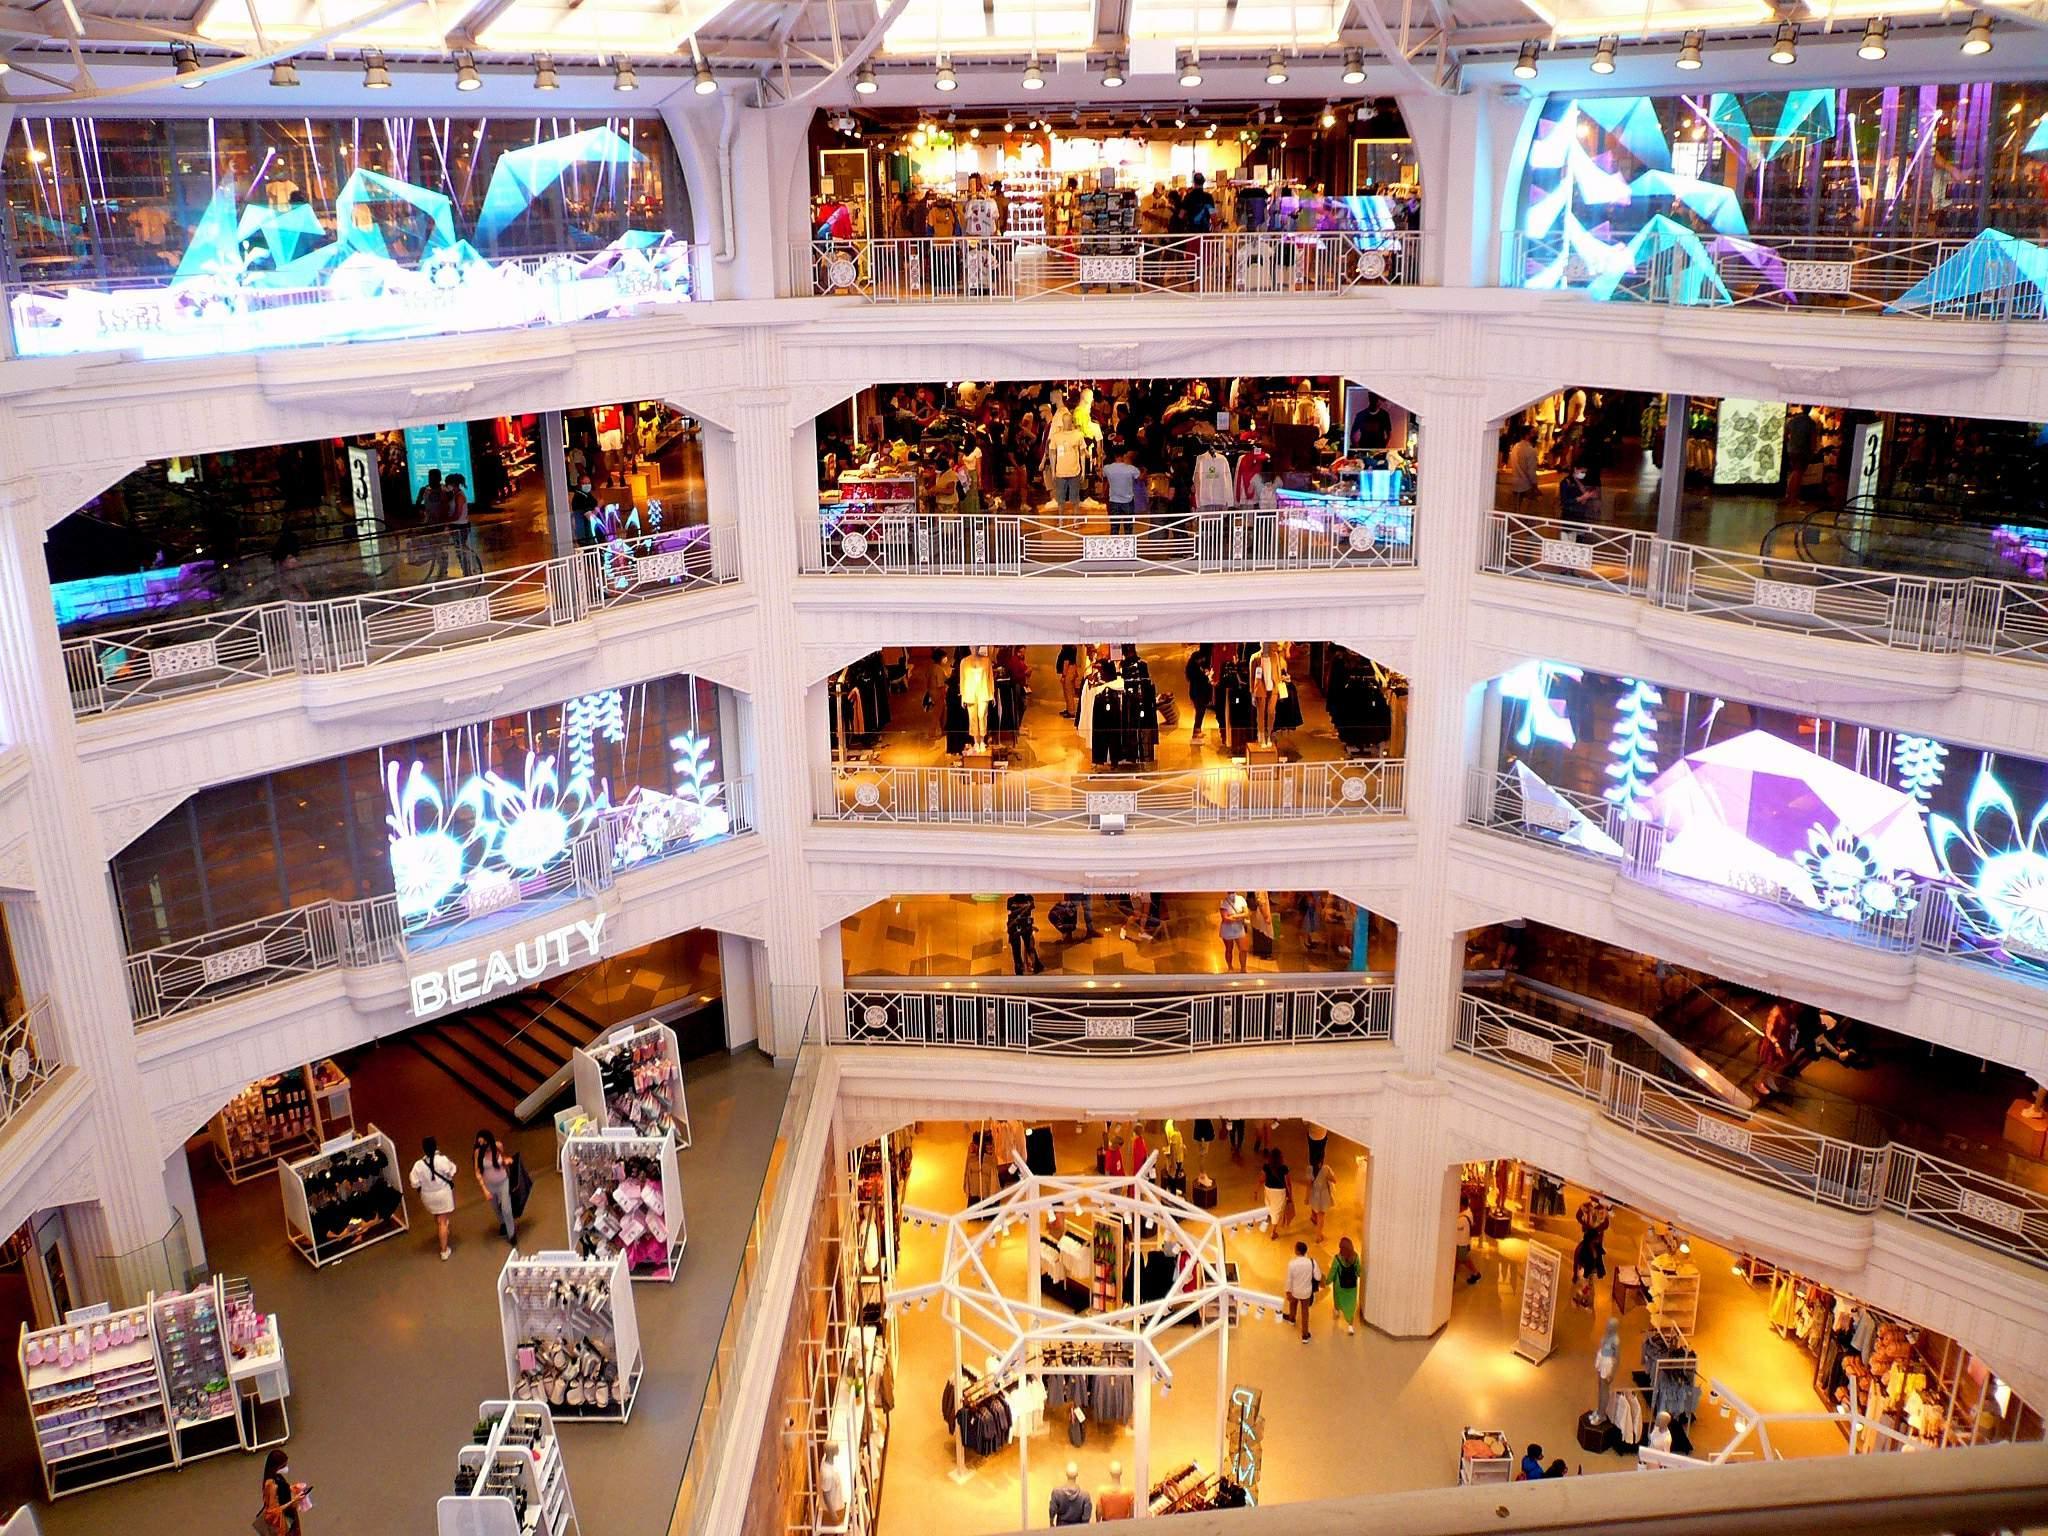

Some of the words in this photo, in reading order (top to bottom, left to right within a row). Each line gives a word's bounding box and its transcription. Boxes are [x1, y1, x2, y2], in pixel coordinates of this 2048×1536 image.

[1864, 434, 1878, 477] 3
[353, 458, 368, 500] 3
[411, 913, 606, 1017] BEAUTY
